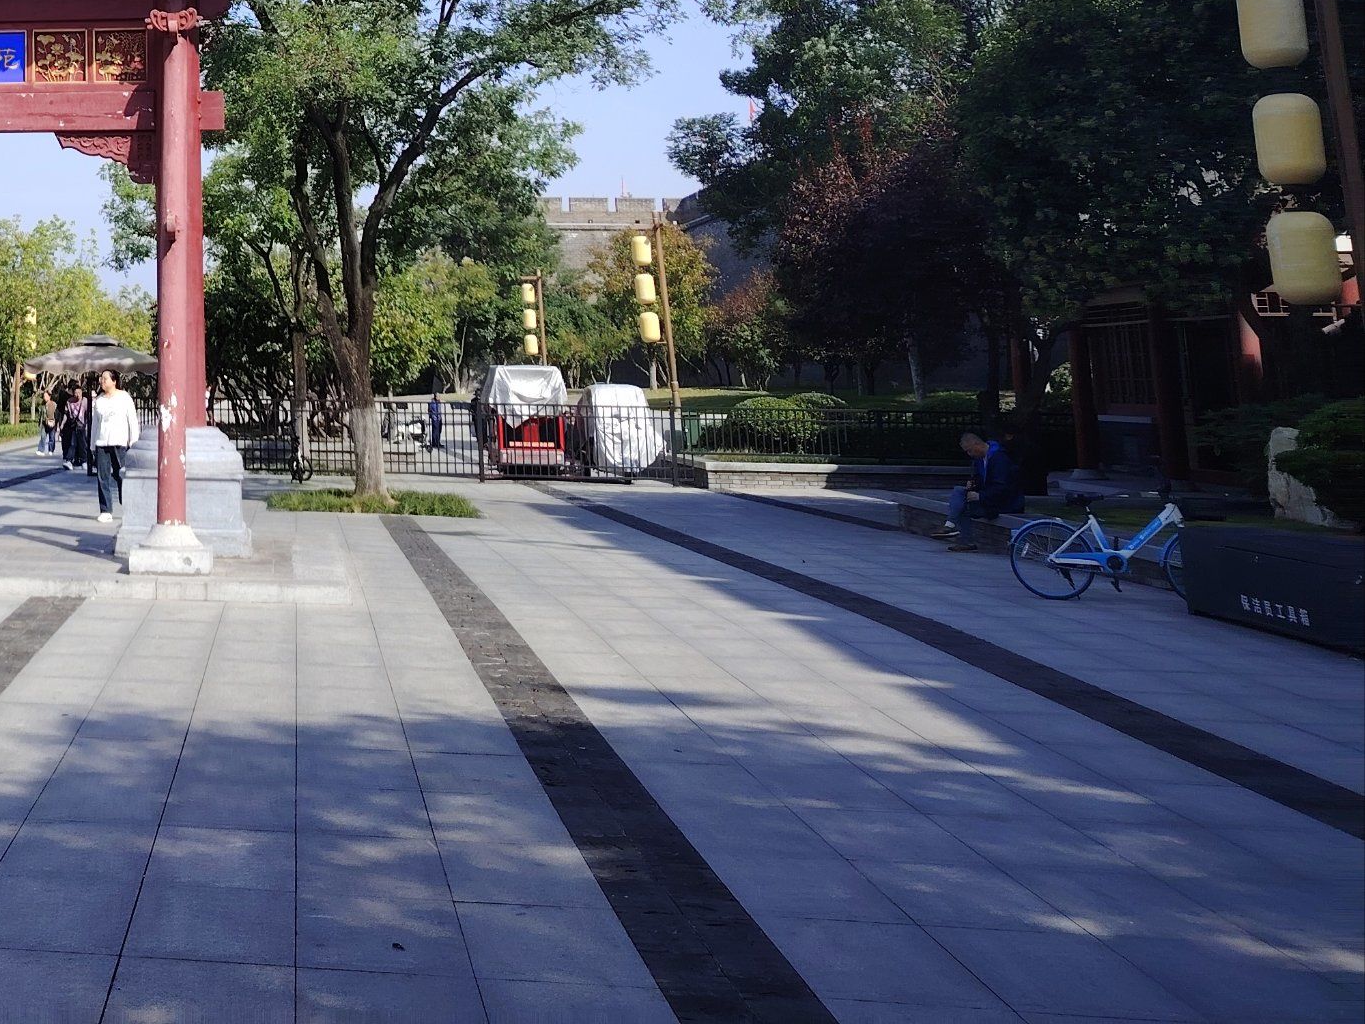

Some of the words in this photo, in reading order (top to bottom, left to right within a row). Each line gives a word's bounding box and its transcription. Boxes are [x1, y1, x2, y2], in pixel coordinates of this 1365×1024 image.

[1240, 594, 1310, 626] 保洁员工具箱
